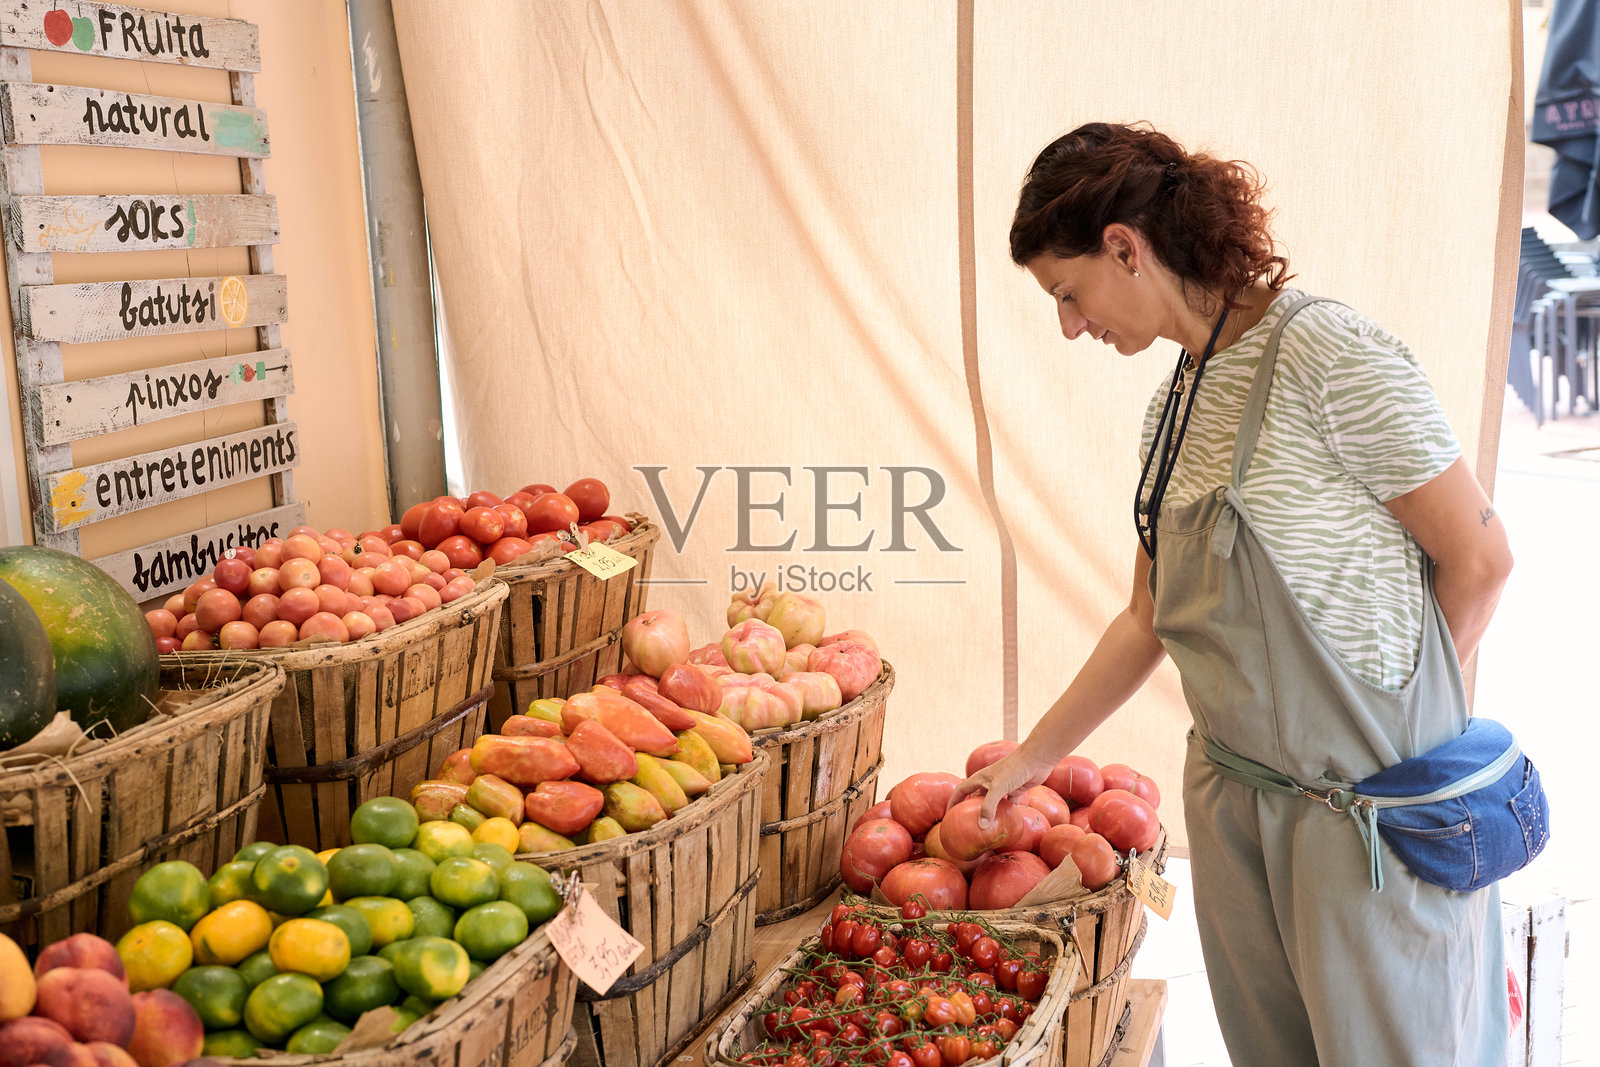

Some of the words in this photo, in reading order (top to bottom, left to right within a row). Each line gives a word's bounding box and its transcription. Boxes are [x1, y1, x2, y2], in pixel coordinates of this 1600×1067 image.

[83, 95, 210, 142] natural
[119, 281, 217, 331] batutsi
[125, 368, 223, 425] pinxos
[95, 429, 296, 508] entreteniments
